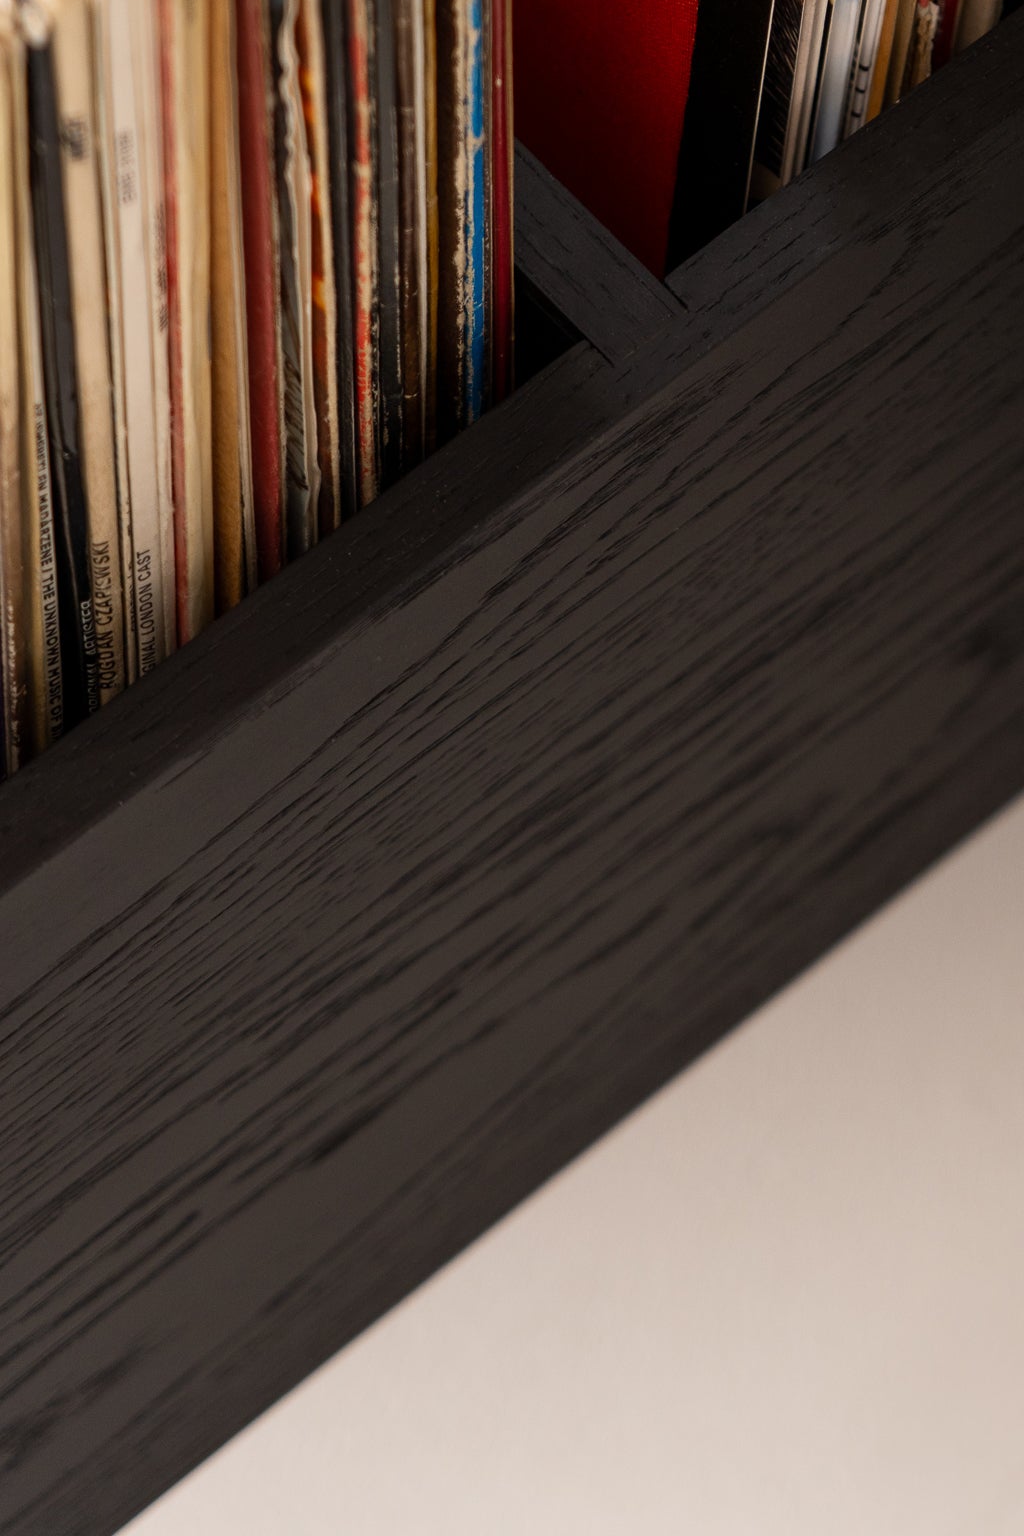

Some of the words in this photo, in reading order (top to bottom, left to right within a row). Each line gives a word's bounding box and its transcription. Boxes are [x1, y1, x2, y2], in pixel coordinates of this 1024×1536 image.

[136, 548, 152, 580] CAST
[45, 575, 56, 599] THE
[138, 583, 154, 635] LONDON
[45, 602, 61, 666] UNKNOWN
[48, 667, 63, 705] MUSIC
